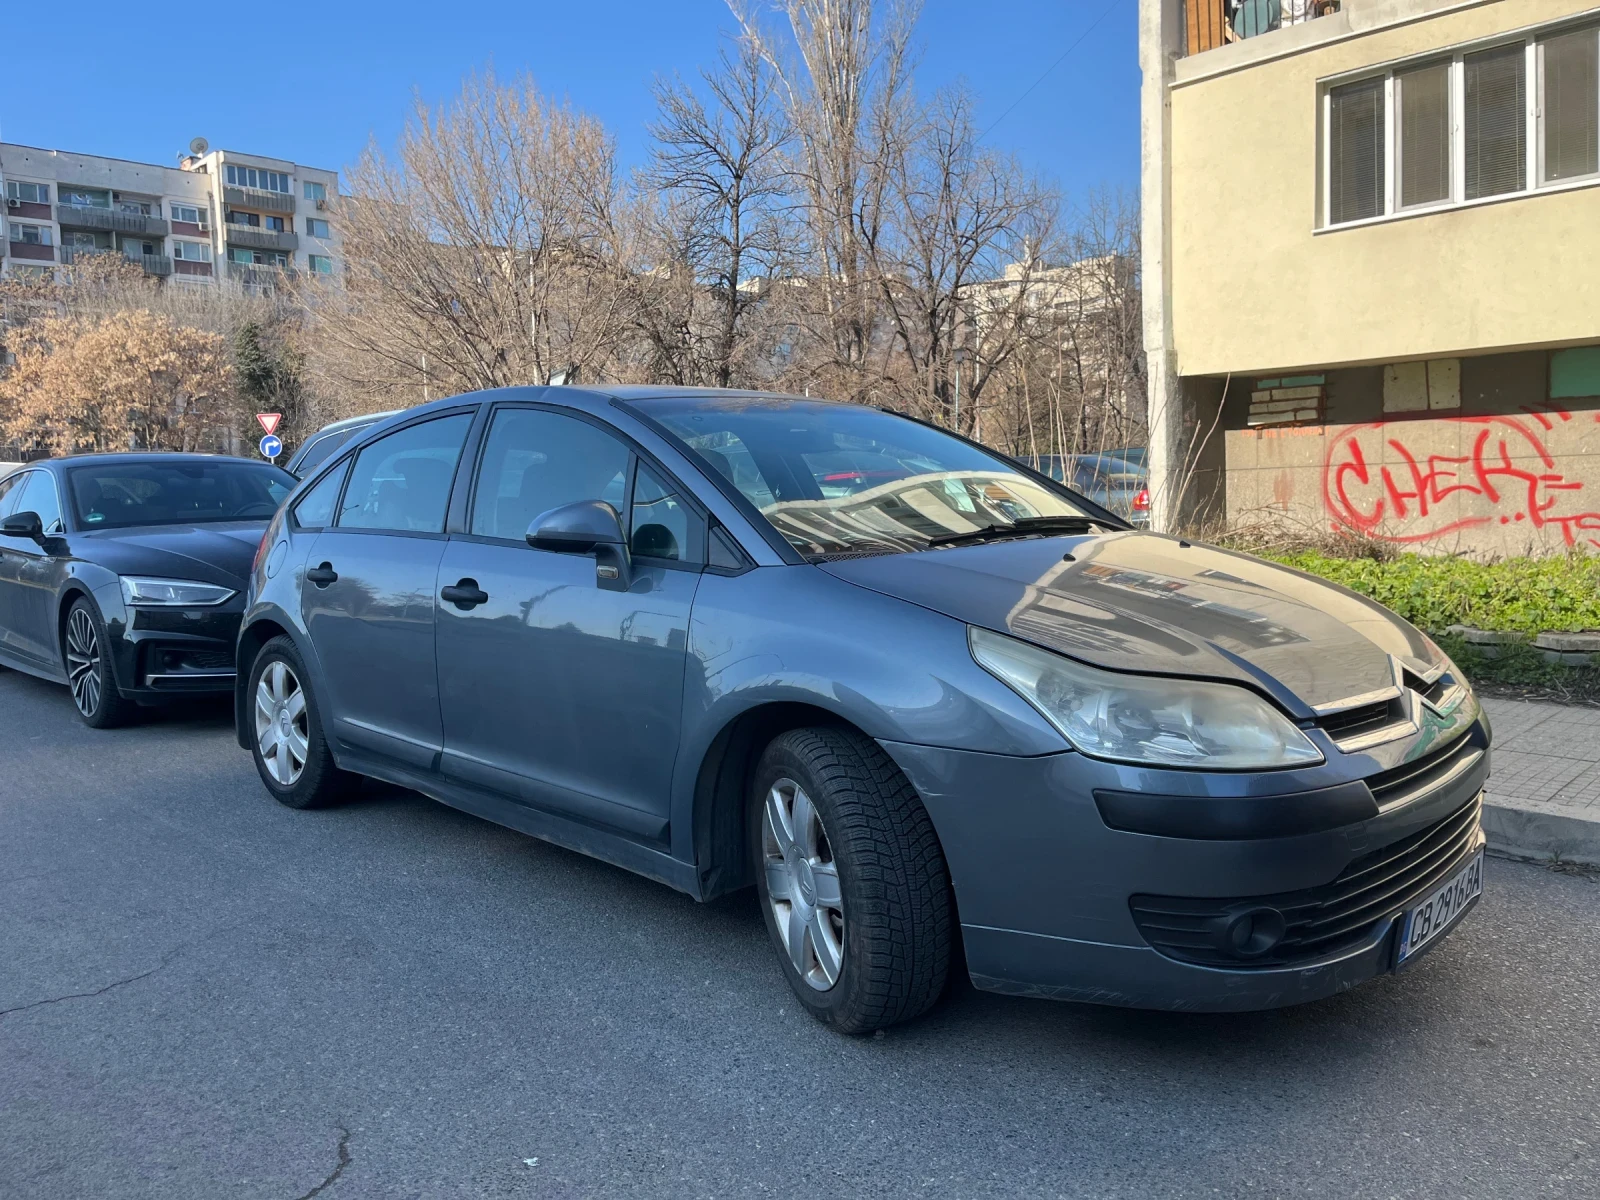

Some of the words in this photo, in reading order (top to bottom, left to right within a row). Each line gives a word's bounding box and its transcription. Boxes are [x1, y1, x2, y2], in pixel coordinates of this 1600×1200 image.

[1410, 901, 1433, 947] CB
[1433, 872, 1467, 931] 2916
[1465, 857, 1480, 899] BA
